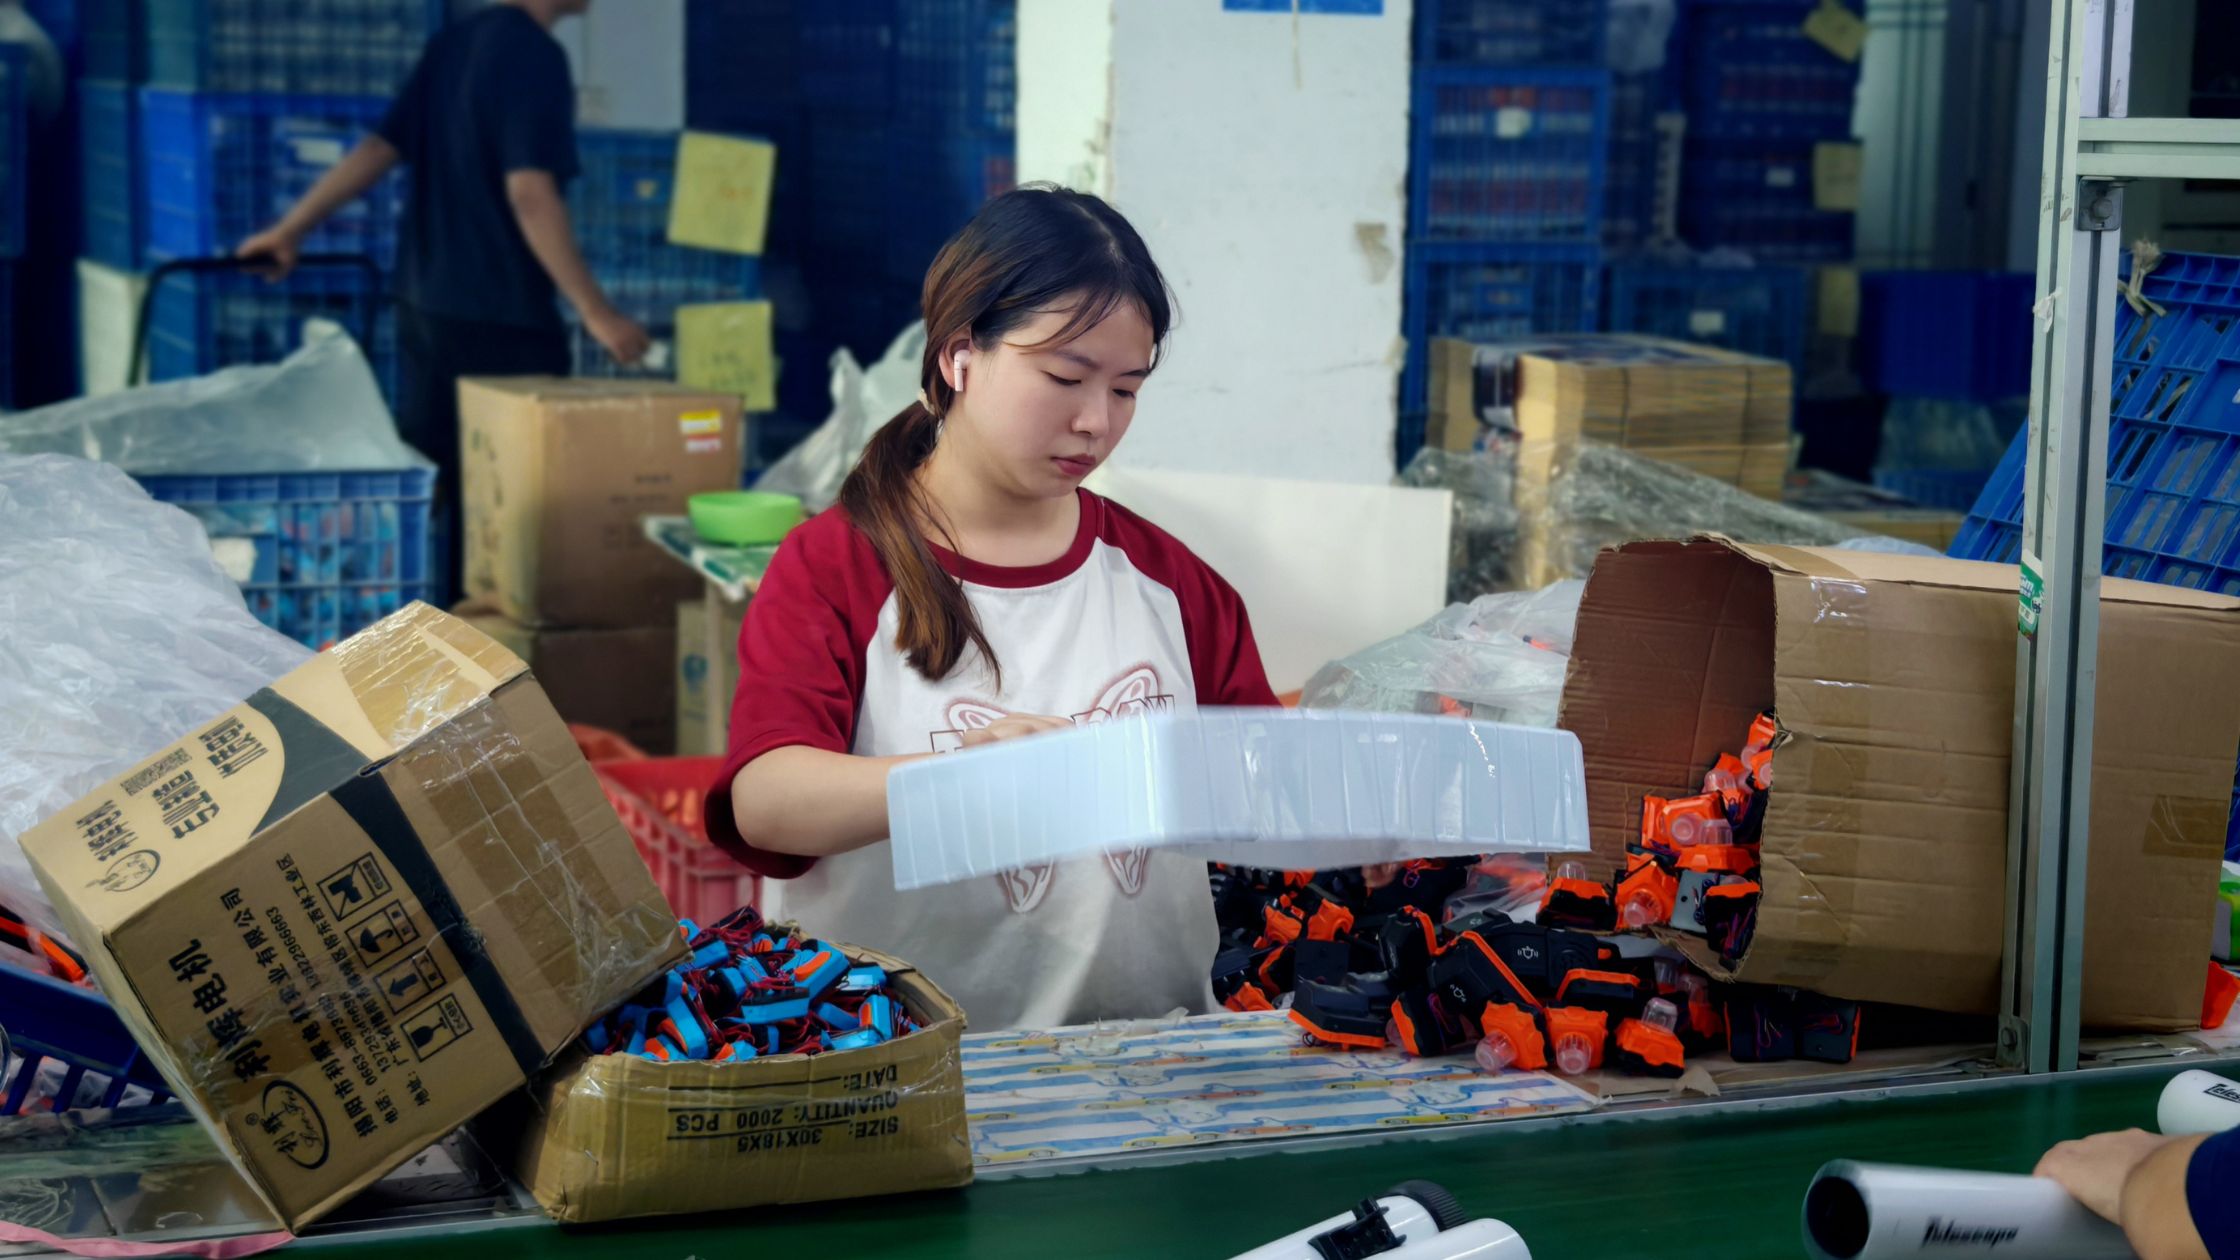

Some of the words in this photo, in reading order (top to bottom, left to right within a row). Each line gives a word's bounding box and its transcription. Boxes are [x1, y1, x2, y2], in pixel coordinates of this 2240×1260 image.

[198, 714, 269, 779] 优质电机
[151, 769, 221, 839] 专业制造
[76, 799, 138, 862] 利辉电机
[168, 938, 273, 1083] 利辉电机
[220, 887, 379, 1137] 揭阳市利辉电机实业有限公司
[844, 1065, 897, 1090] DATE:
[738, 1108, 783, 1128] 2000
[795, 1091, 898, 1120] QUANTITY:
[676, 1114, 719, 1131] PCS
[849, 1117, 898, 1138] SIZE:
[738, 1129, 822, 1152] 30X18X5
